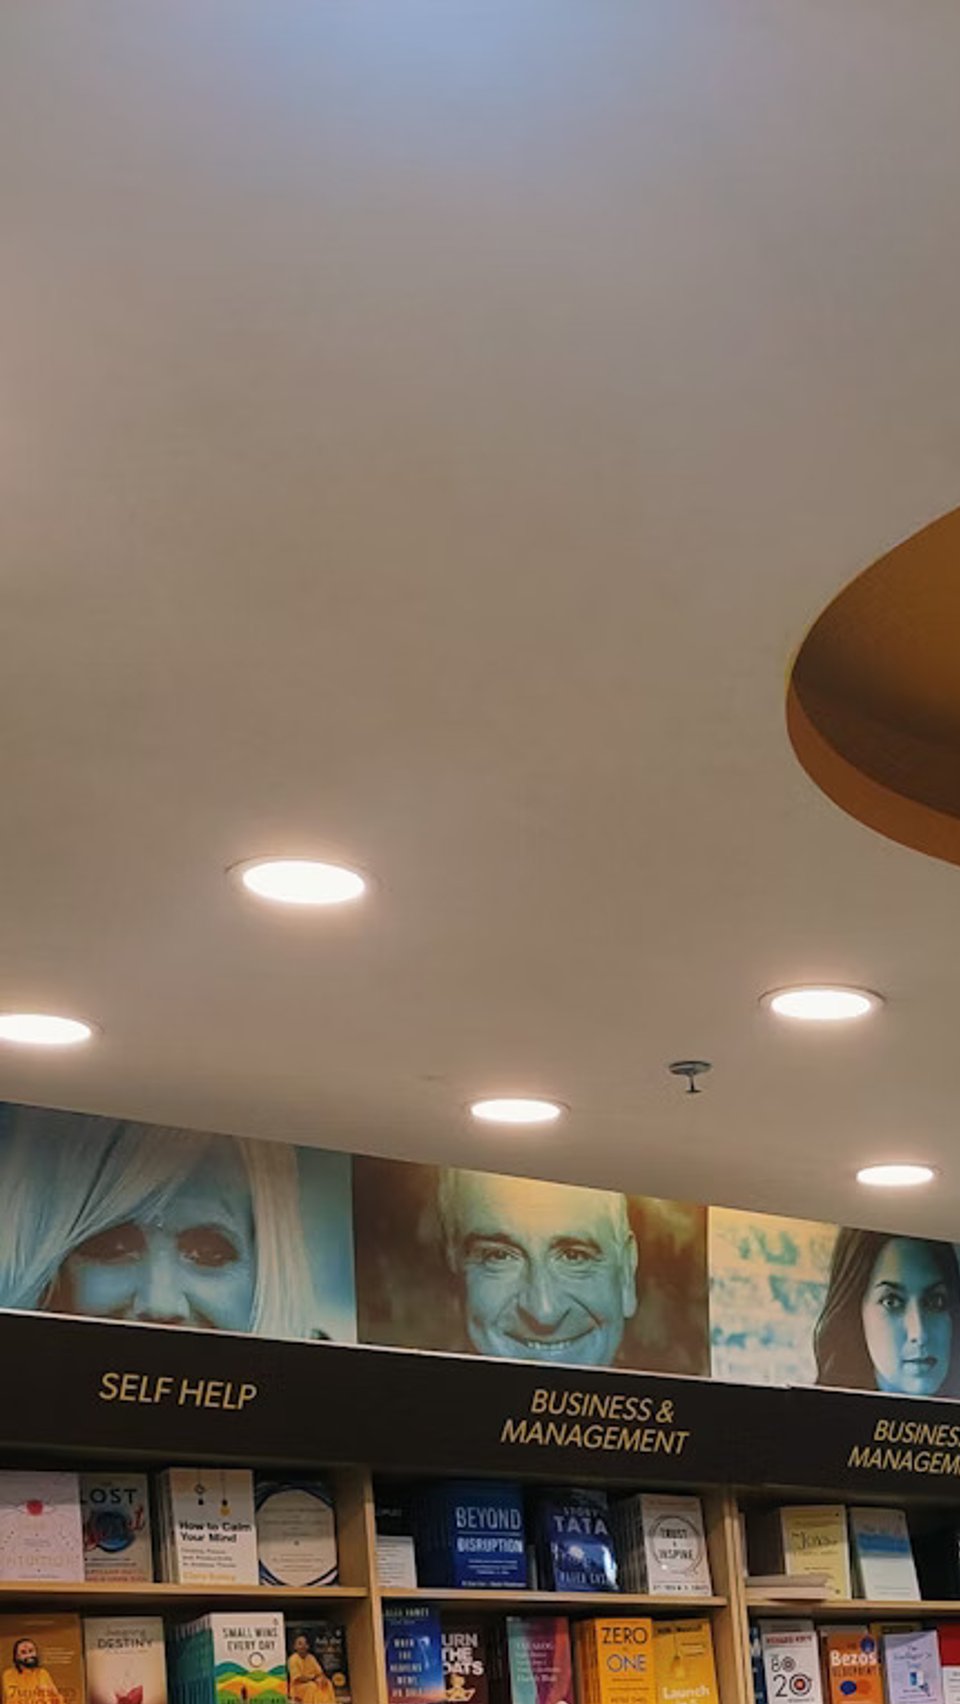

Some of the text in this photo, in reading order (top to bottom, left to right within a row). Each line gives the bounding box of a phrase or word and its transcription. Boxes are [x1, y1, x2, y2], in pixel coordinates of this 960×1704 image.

[99, 1372, 257, 1411] SELF HELP
[530, 1389, 675, 1424] BUSINESS &
[501, 1419, 689, 1456] MANAGEMENT
[456, 1507, 522, 1530] BEYOND
[553, 1515, 608, 1535] TATA
[457, 1538, 523, 1553] DISRUPTION
[601, 1627, 648, 1645] ZERO
[606, 1654, 647, 1673] ONE
[829, 1651, 877, 1666] Bezos
[662, 1686, 710, 1700] Launch
